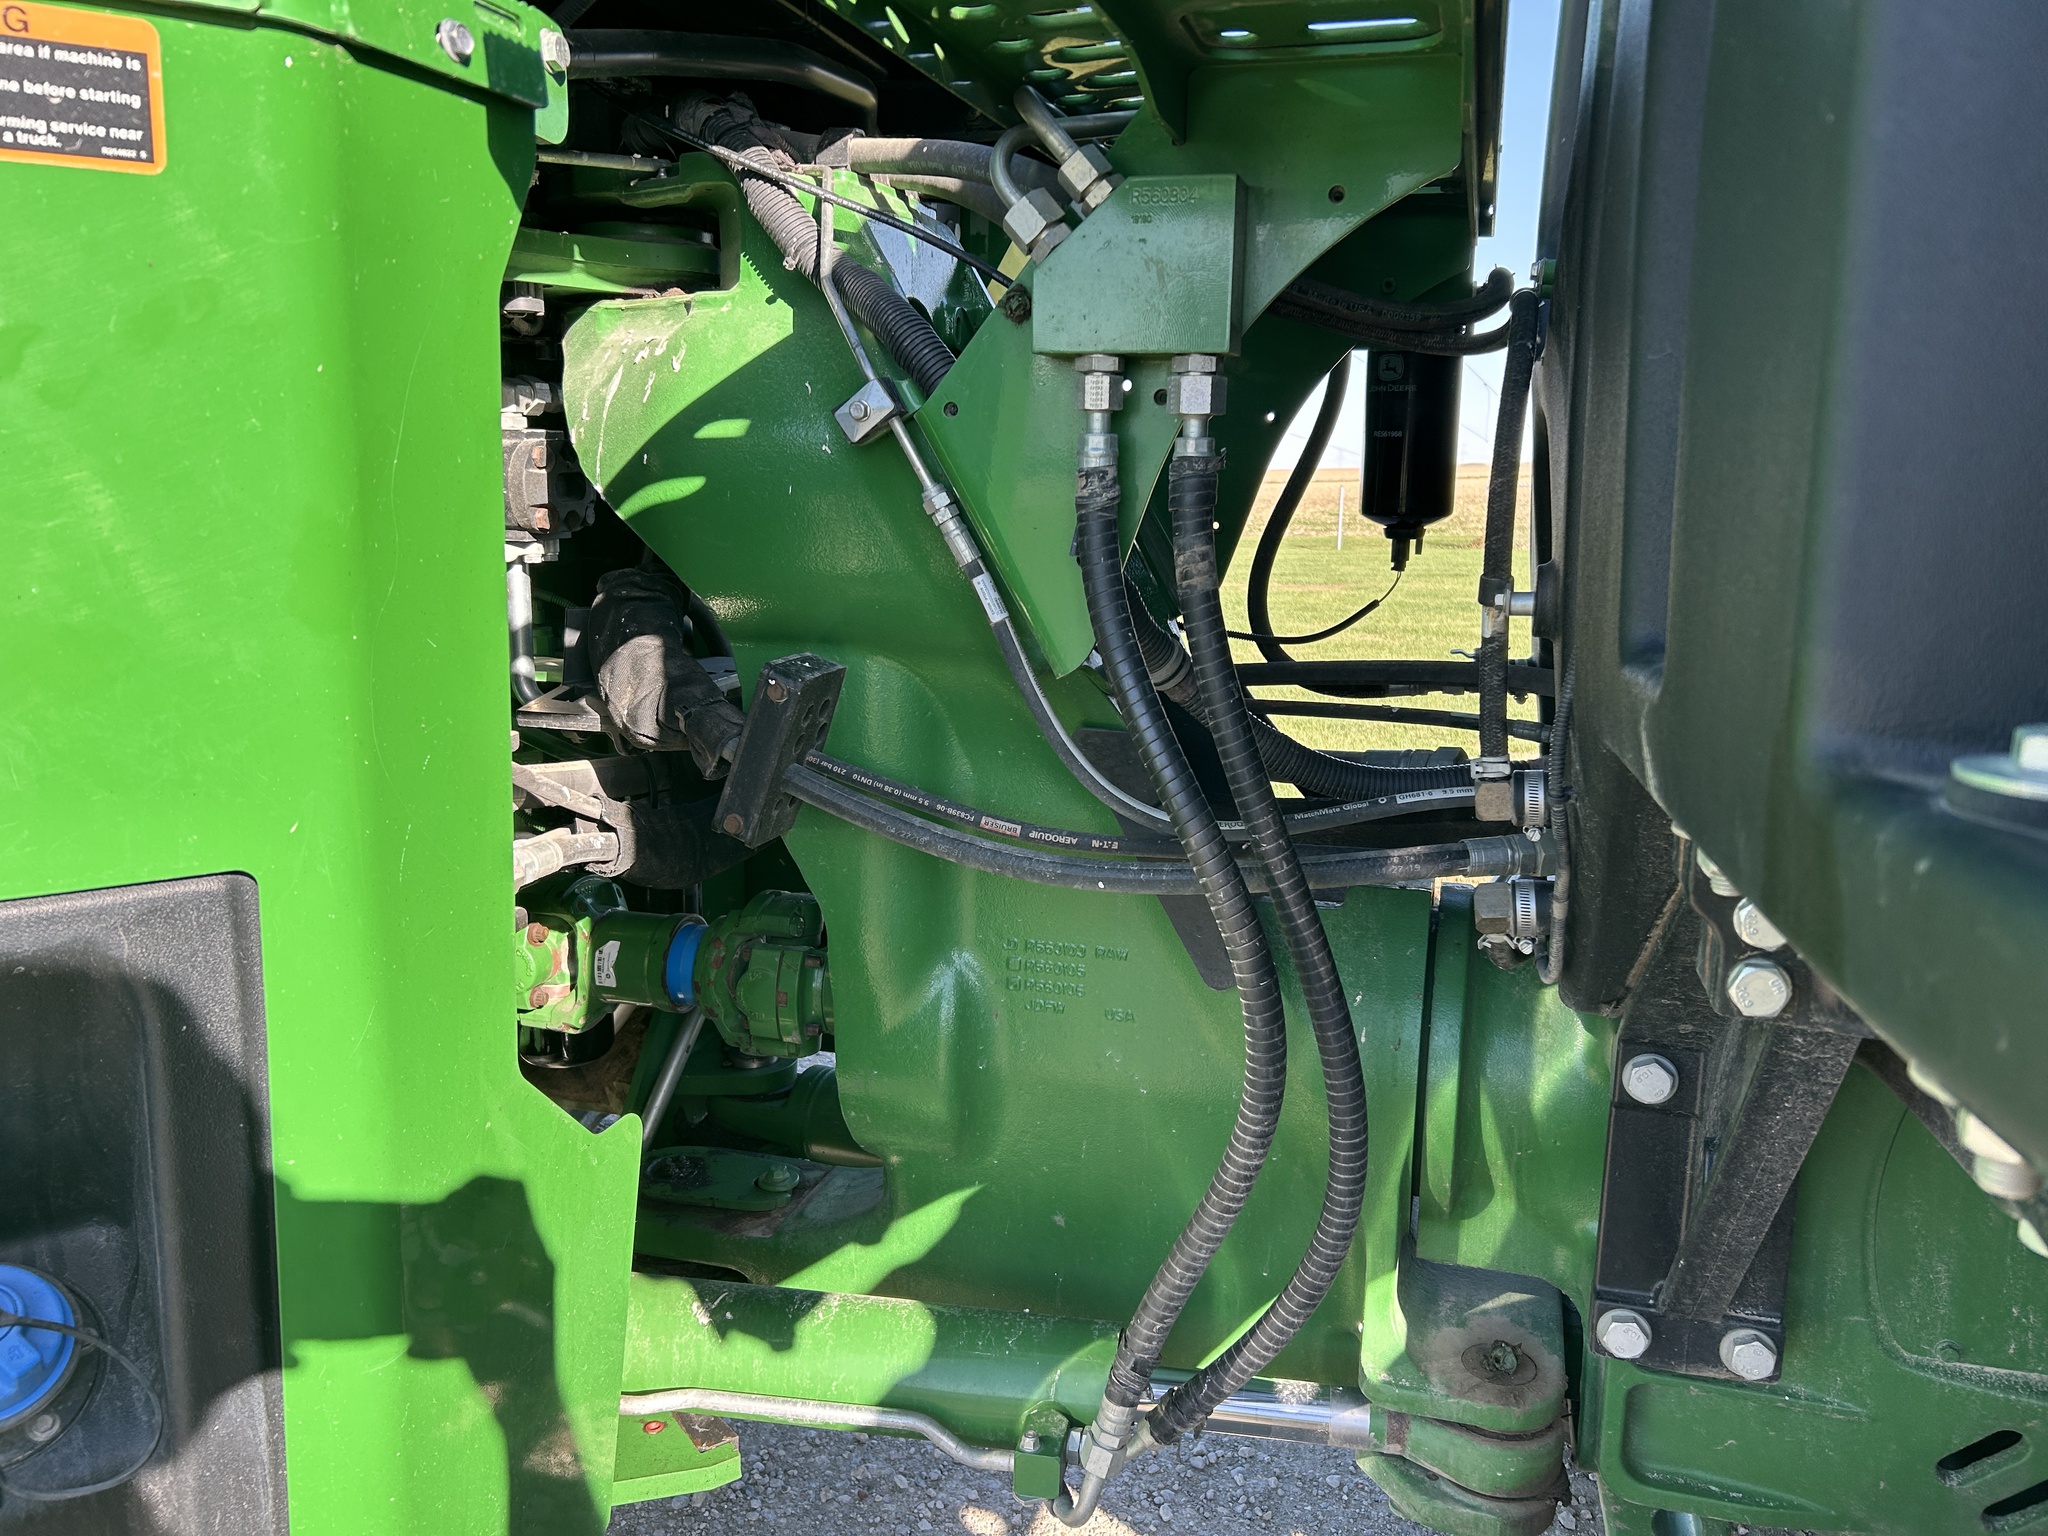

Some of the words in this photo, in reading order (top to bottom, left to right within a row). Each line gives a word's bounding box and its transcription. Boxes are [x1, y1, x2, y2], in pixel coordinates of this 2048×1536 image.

[3, 5, 29, 33] G
[0, 42, 35, 58] area
[38, 44, 50, 60] if
[54, 49, 123, 69] machine
[126, 56, 142, 71] is
[23, 79, 76, 99] before
[79, 87, 141, 109] starting
[50, 120, 106, 138] service
[109, 127, 144, 141] near
[3, 131, 14, 143] a
[16, 131, 62, 148] truck.
[1387, 384, 1418, 392] DEERE
[820, 759, 833, 769] bar
[833, 766, 847, 776] 210
[852, 773, 873, 786] DN10
[903, 791, 918, 801] mm
[1294, 807, 1341, 820] MatchMate
[1342, 801, 1370, 811] Global
[983, 818, 1019, 834] BRUISER
[1028, 830, 1079, 846] AEROQUIP
[1104, 1007, 1136, 1023] USA
